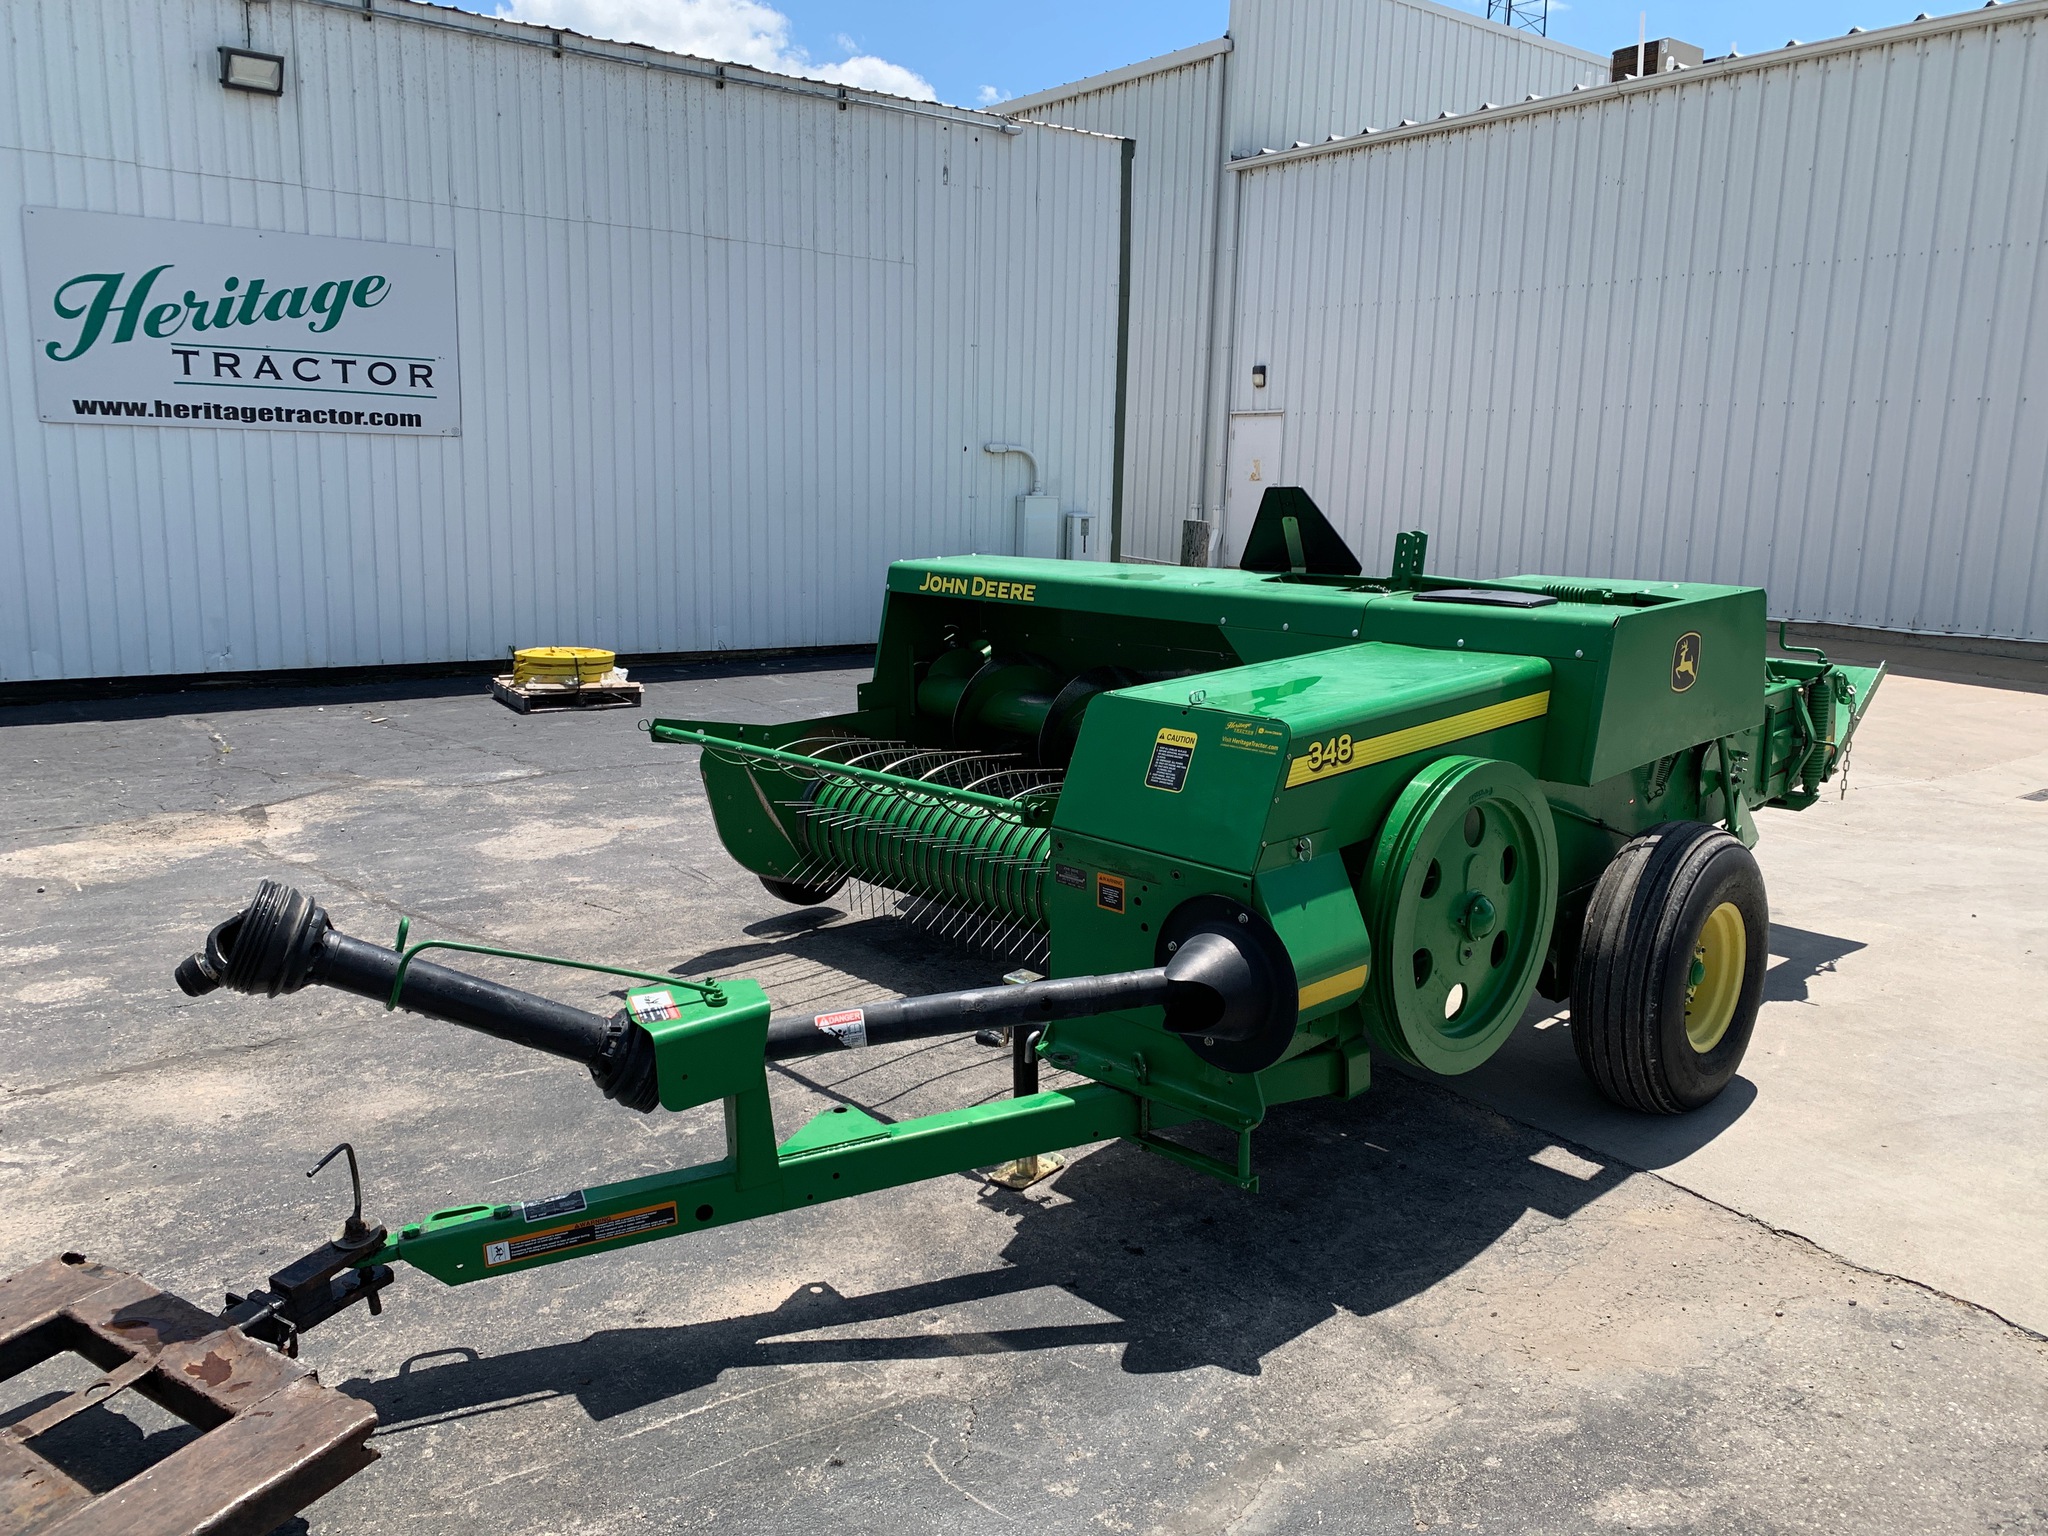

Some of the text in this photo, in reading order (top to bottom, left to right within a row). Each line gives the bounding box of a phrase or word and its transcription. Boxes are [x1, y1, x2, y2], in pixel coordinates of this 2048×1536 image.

[45, 264, 392, 362] Heritage
[171, 348, 435, 389] TRACTOR
[72, 399, 423, 428] www.heritagetractor.com
[918, 572, 1037, 601] JOHN DEERE
[1166, 733, 1195, 744] CAUTION
[1307, 733, 1353, 772] 348
[828, 1011, 861, 1024] DANGER
[579, 1216, 612, 1229] WARNING
